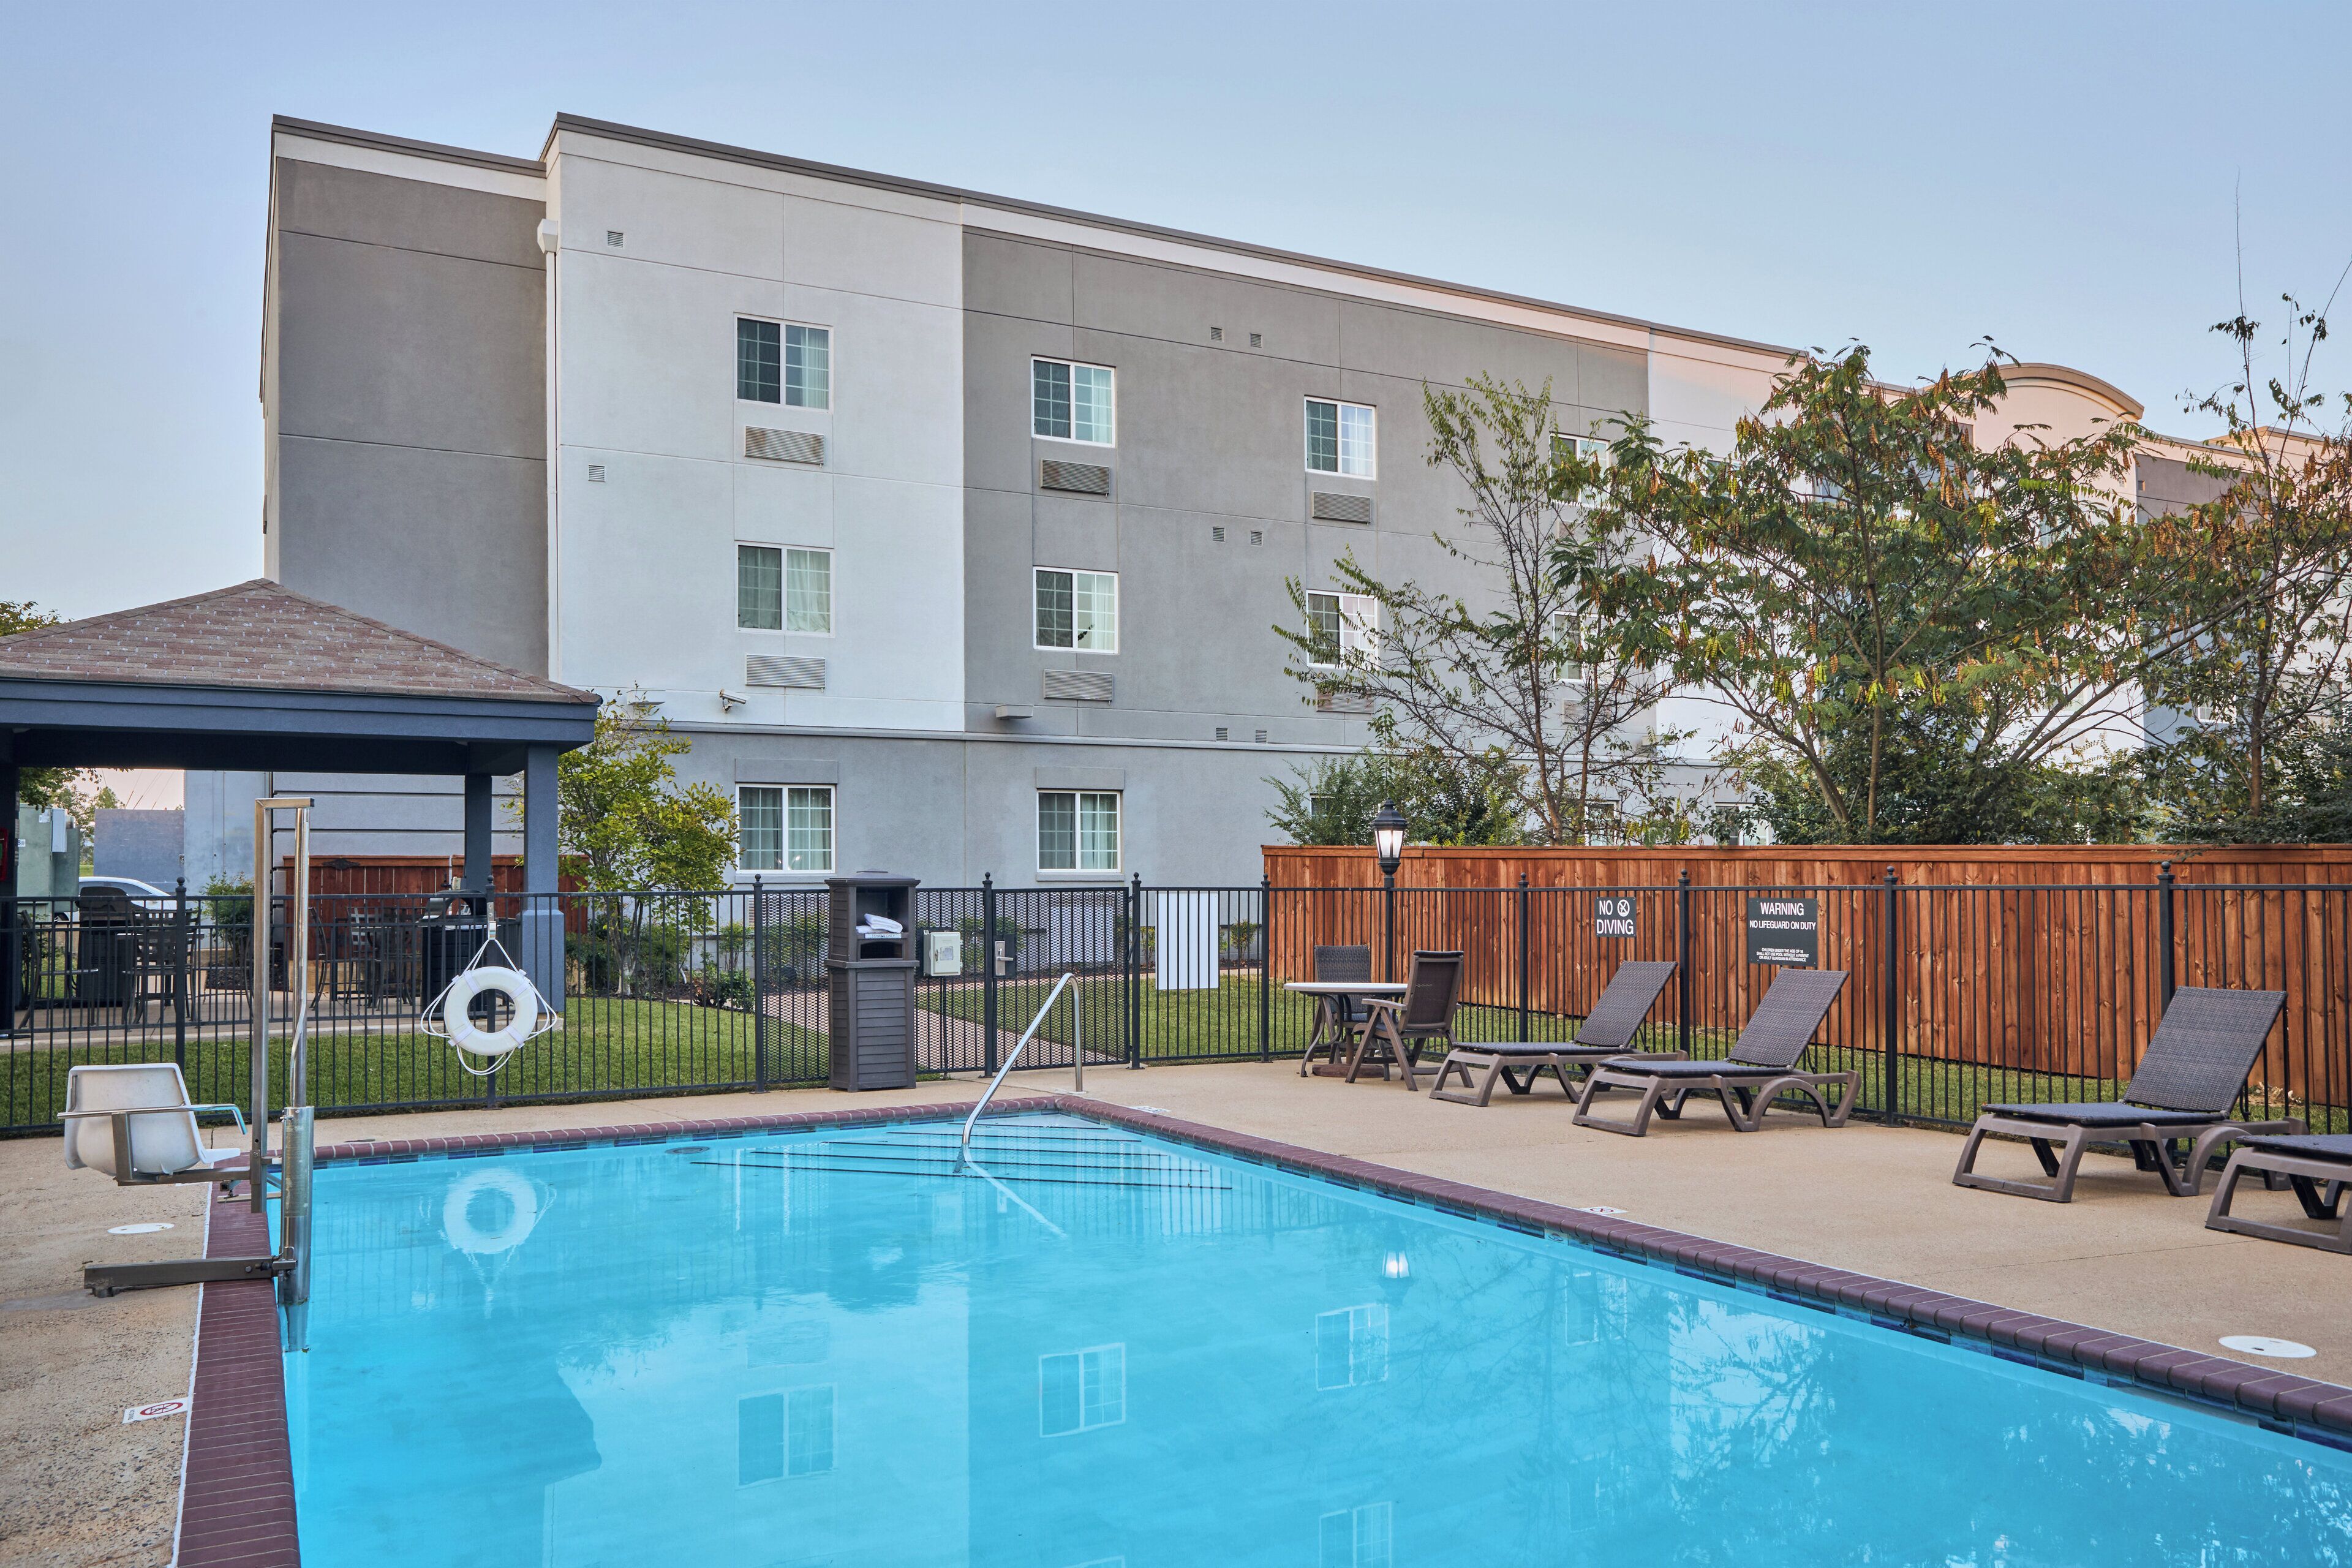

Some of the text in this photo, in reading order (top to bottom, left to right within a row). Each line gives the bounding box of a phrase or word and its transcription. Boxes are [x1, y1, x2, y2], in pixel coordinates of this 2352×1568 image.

[1599, 900, 1613, 916] NO
[1760, 902, 1804, 916] WARNING
[1596, 919, 1634, 935] DIVING
[1758, 921, 1790, 929] LIFEGUARD
[1790, 921, 1800, 930] ON
